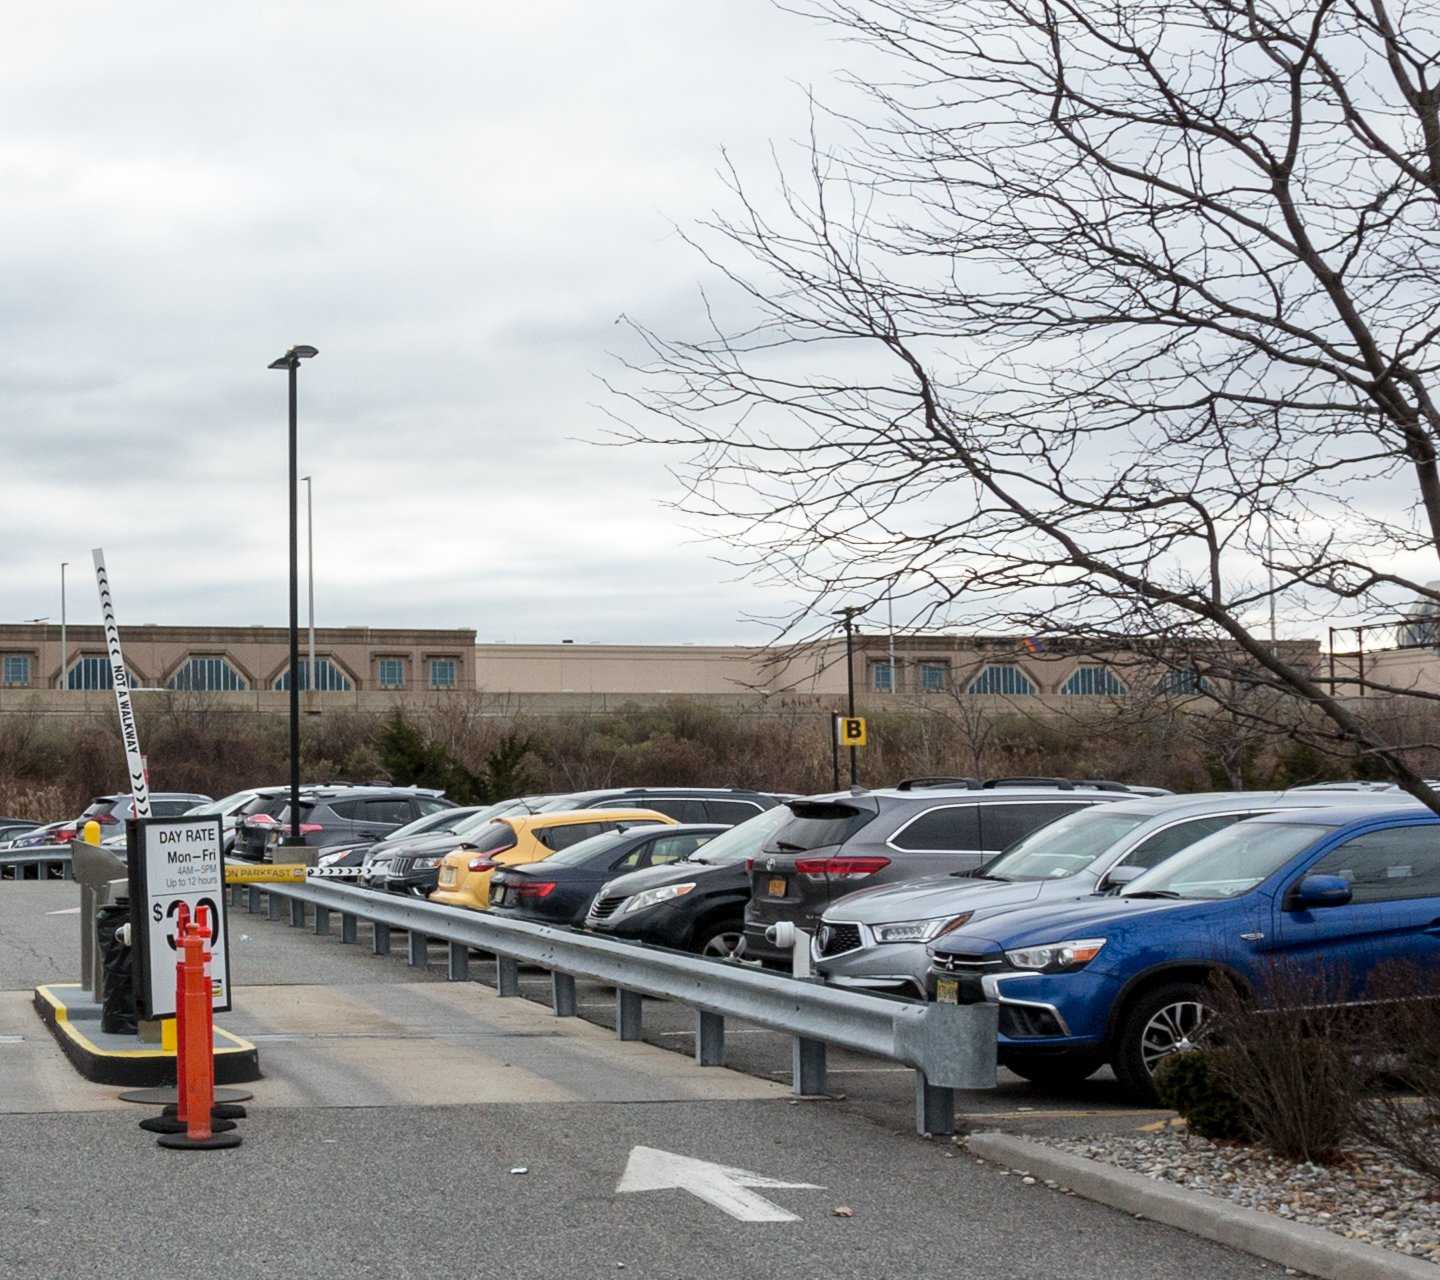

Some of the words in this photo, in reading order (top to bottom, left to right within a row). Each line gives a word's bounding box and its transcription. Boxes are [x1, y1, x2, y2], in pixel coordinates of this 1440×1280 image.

[114, 665, 127, 688] NOT
[120, 700, 138, 754] WALKWAY
[847, 720, 862, 738] B
[159, 831, 181, 844] DAY
[186, 828, 215, 842] RATE
[166, 879, 176, 889] Up
[178, 878, 186, 888] to
[188, 876, 196, 886] 12
[197, 875, 217, 886] hours
